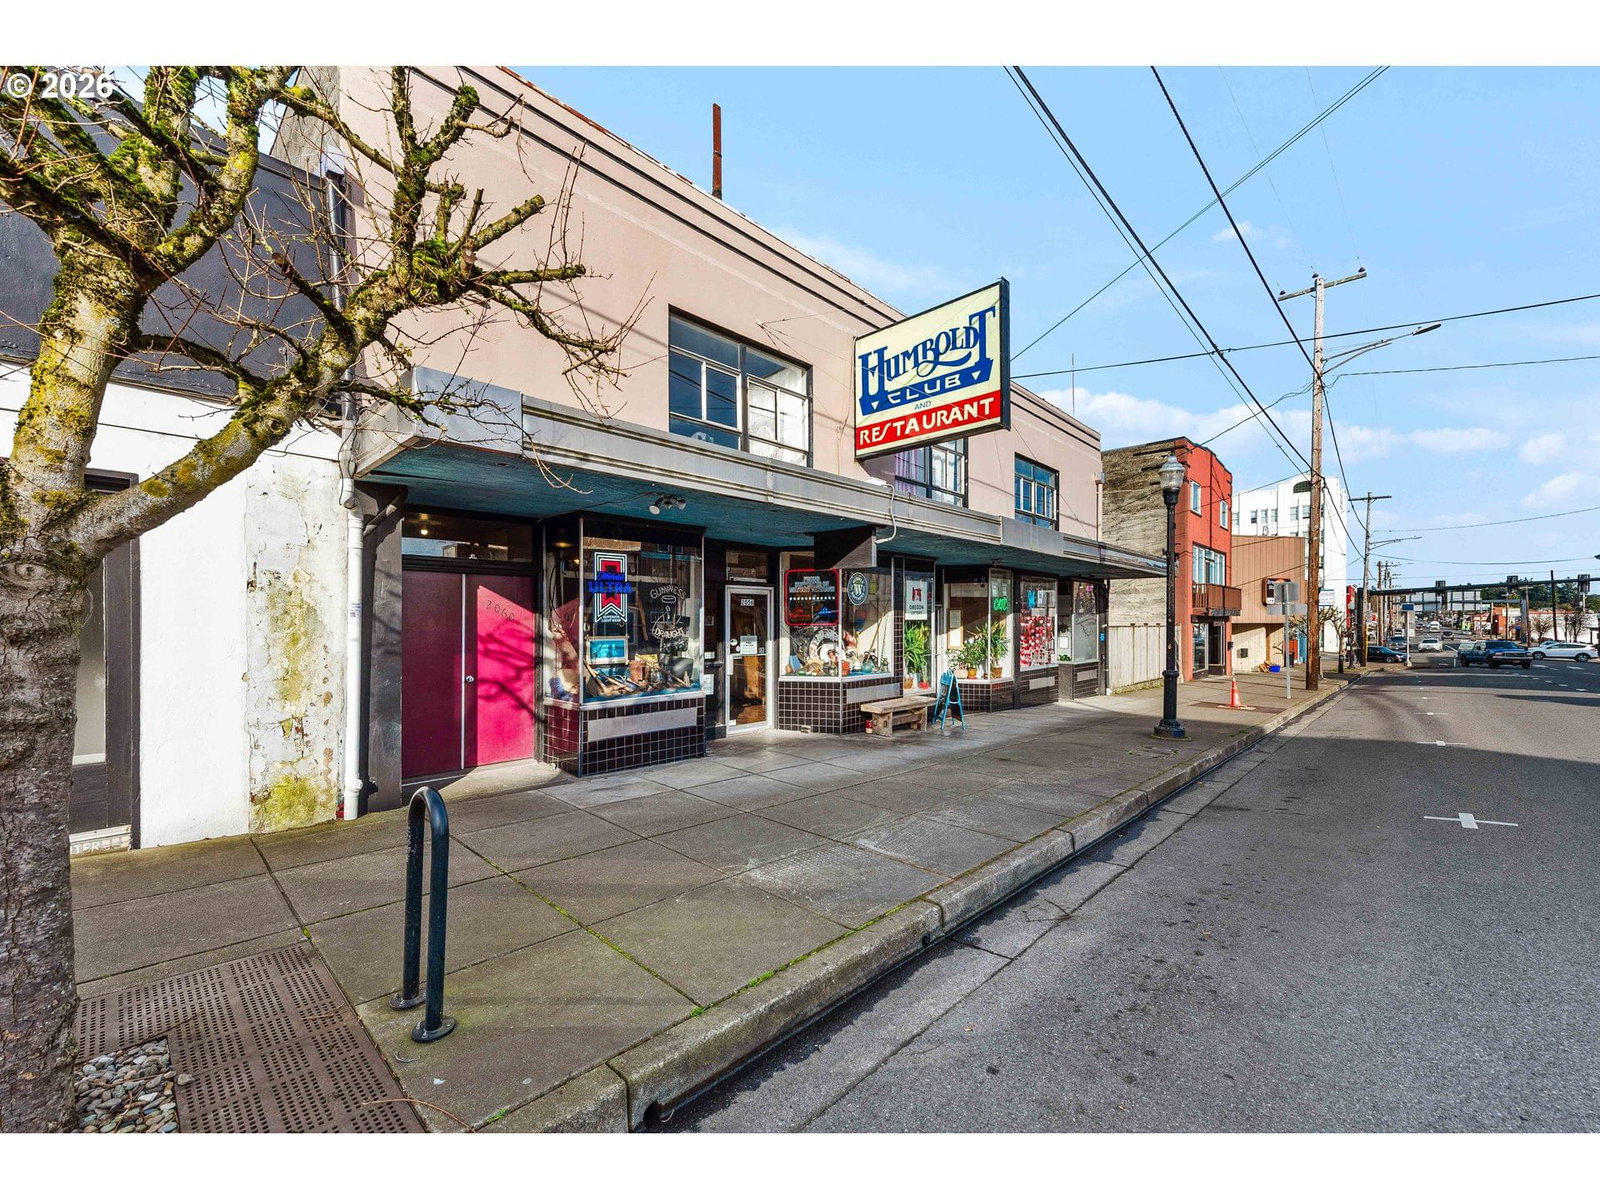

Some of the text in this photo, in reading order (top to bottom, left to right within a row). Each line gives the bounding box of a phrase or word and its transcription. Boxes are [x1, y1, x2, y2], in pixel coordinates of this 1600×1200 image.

[858, 306, 996, 396] HUMBOLDT
[887, 374, 962, 404] CLUB
[914, 400, 932, 411] AND
[859, 397, 995, 446] RESTAURANT
[588, 580, 633, 593] ULTRA
[486, 599, 515, 621] 2060
